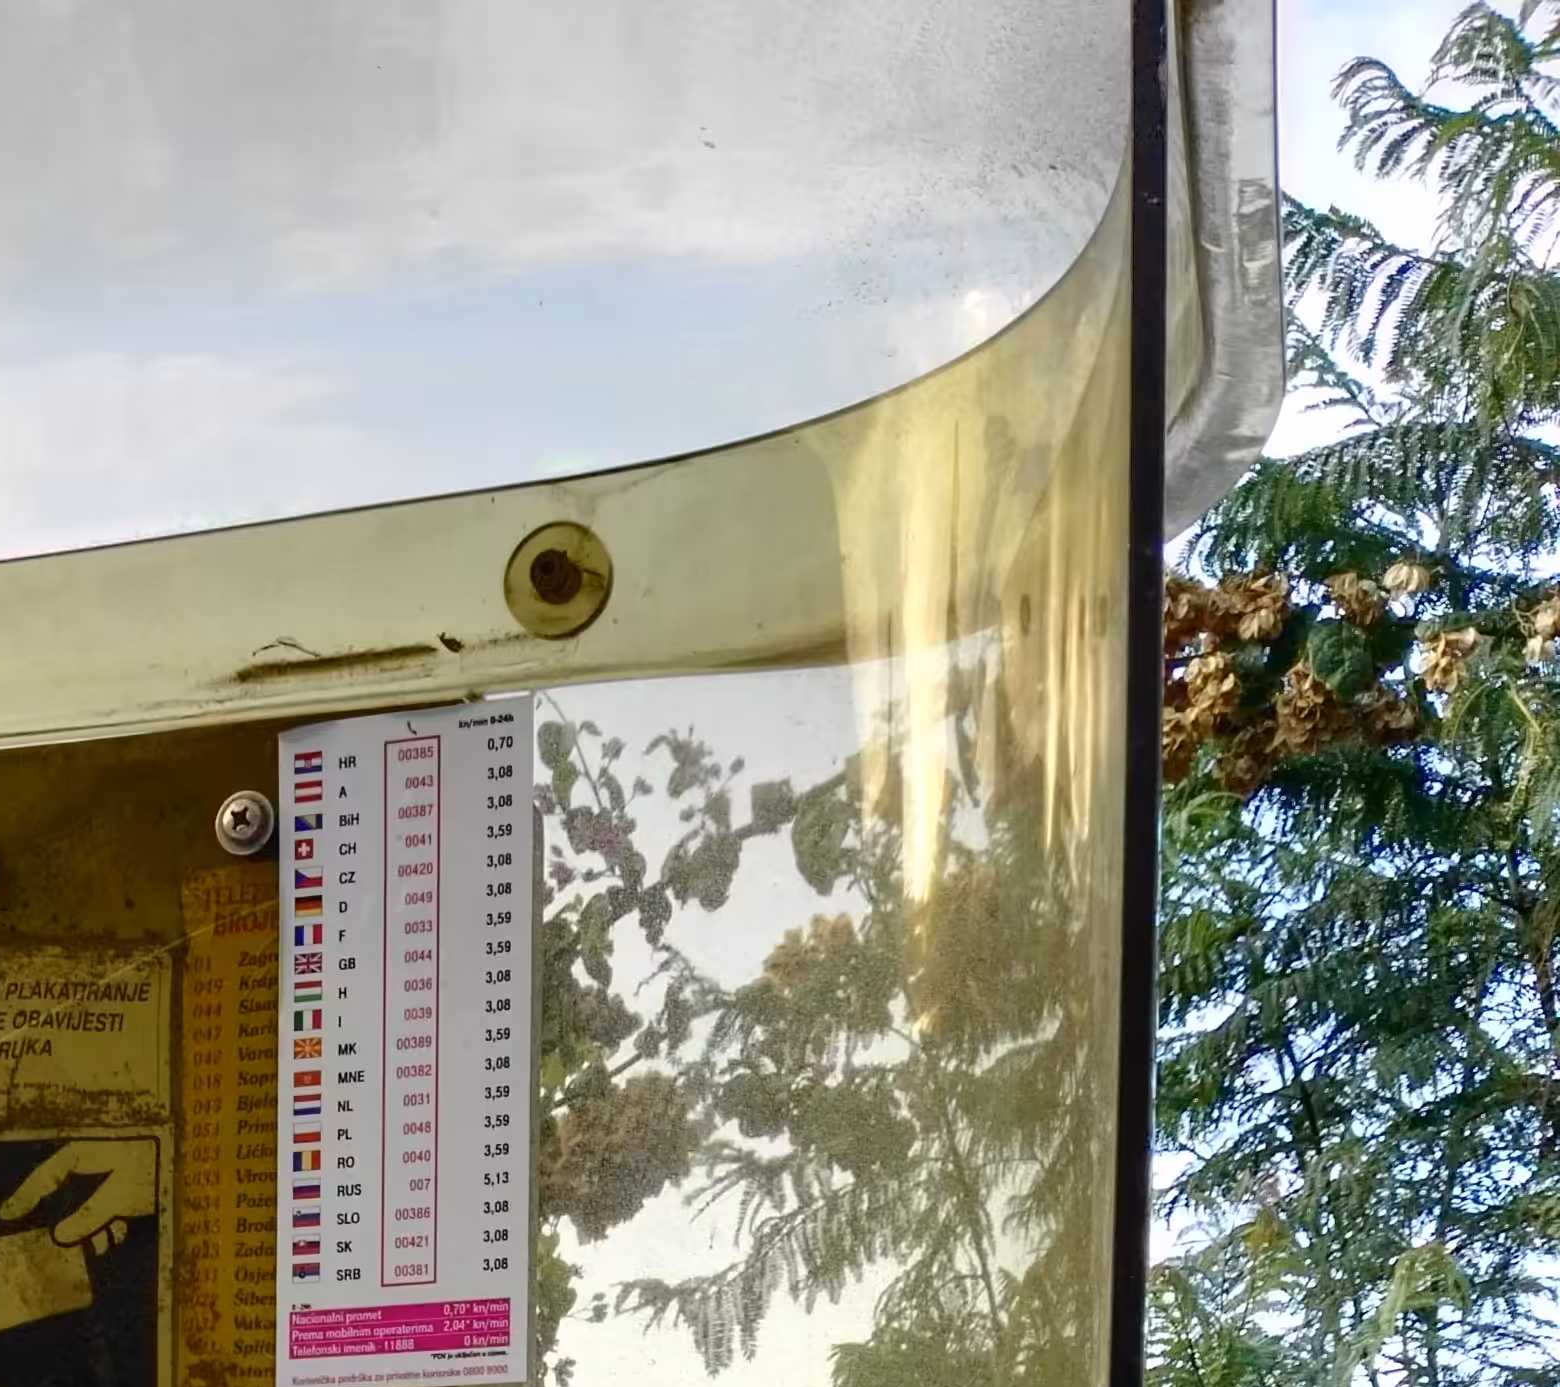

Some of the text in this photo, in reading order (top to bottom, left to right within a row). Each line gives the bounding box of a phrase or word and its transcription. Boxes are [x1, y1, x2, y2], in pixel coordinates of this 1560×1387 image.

[339, 736, 513, 769] HR 00385 0,70
[339, 765, 513, 798] A 0043 3,08
[339, 794, 513, 827] BiH 00387 3,08
[339, 823, 512, 856] CH 0041 3,59
[339, 853, 512, 884] CZ 00420 3,08
[339, 882, 512, 913] D 0049 3,08
[339, 911, 511, 942] F 0033 3,59
[338, 940, 511, 970] GB 0044 3,59
[338, 969, 511, 999] H 0036 3,08
[12, 1009, 125, 1032] OBAVIJESTI
[404, 1007, 432, 1020] 0039
[485, 998, 511, 1014] 3,08
[338, 1027, 510, 1056] MK 00389 3,59
[338, 1056, 510, 1084] MNE 00382 3,08
[338, 1085, 510, 1112] NL 0031 3,59
[337, 1114, 510, 1141] PL 0048 3,59
[337, 1143, 509, 1169] RO 0040 3,59
[337, 1171, 509, 1197] RUS 007 5,13
[337, 1200, 509, 1225] SLO 00386 3,08
[336, 1229, 508, 1253] SK 00421 3,08
[336, 1257, 508, 1281] SRB 00381 3,08
[291, 1313, 344, 1325] Nacionalni
[346, 1311, 382, 1324] promet
[473, 1301, 509, 1314] kn/min
[292, 1329, 324, 1341] Prema
[325, 1326, 371, 1339] mobilnim
[373, 1323, 434, 1338] operaterima
[473, 1317, 509, 1330] kn/min
[292, 1343, 341, 1357] Telefonski
[343, 1342, 377, 1354] imenik
[464, 1336, 471, 1347] 0
[473, 1334, 509, 1346] kn/min
